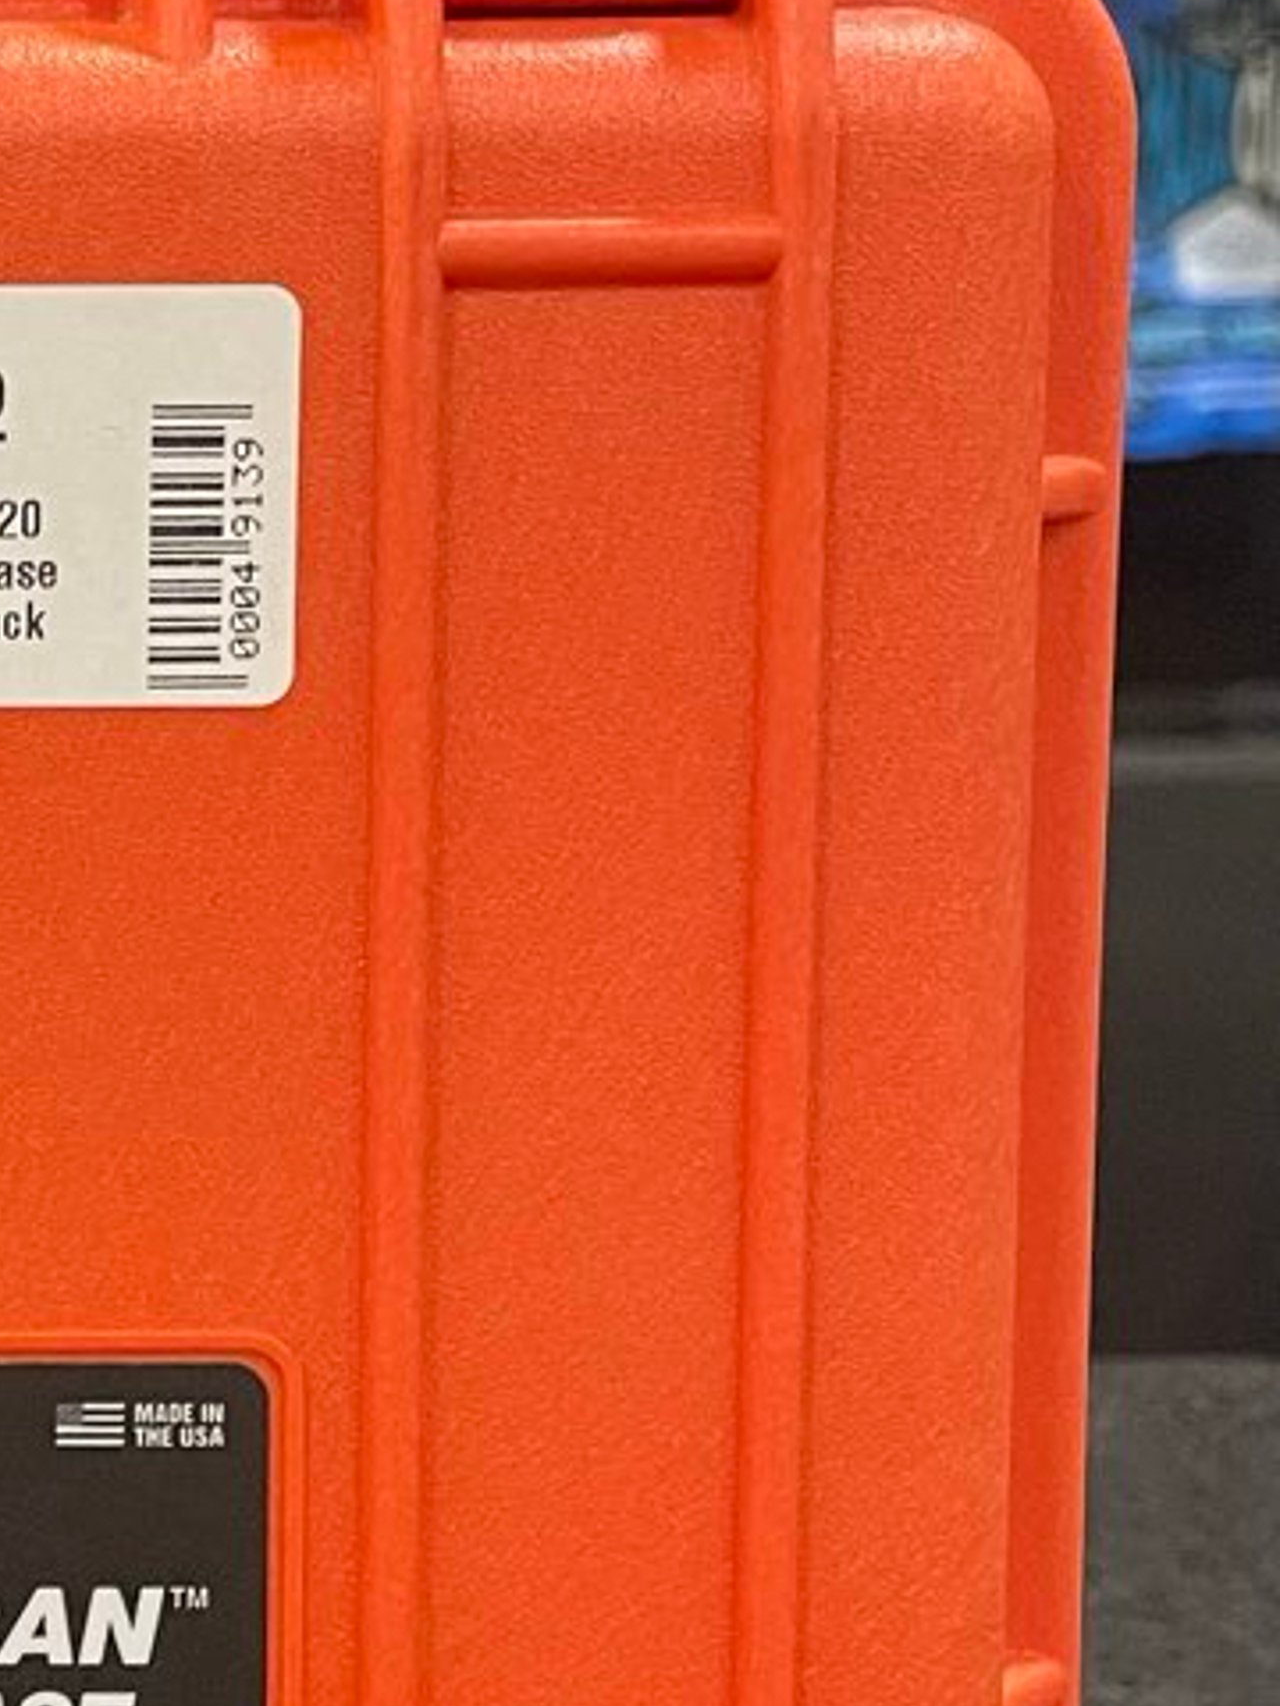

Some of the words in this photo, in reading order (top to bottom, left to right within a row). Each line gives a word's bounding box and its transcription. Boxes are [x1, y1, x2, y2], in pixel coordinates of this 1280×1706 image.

[134, 1402, 194, 1424] MADE
[201, 1403, 225, 1423] IN
[134, 1425, 174, 1448] THE
[179, 1425, 225, 1448] USA
